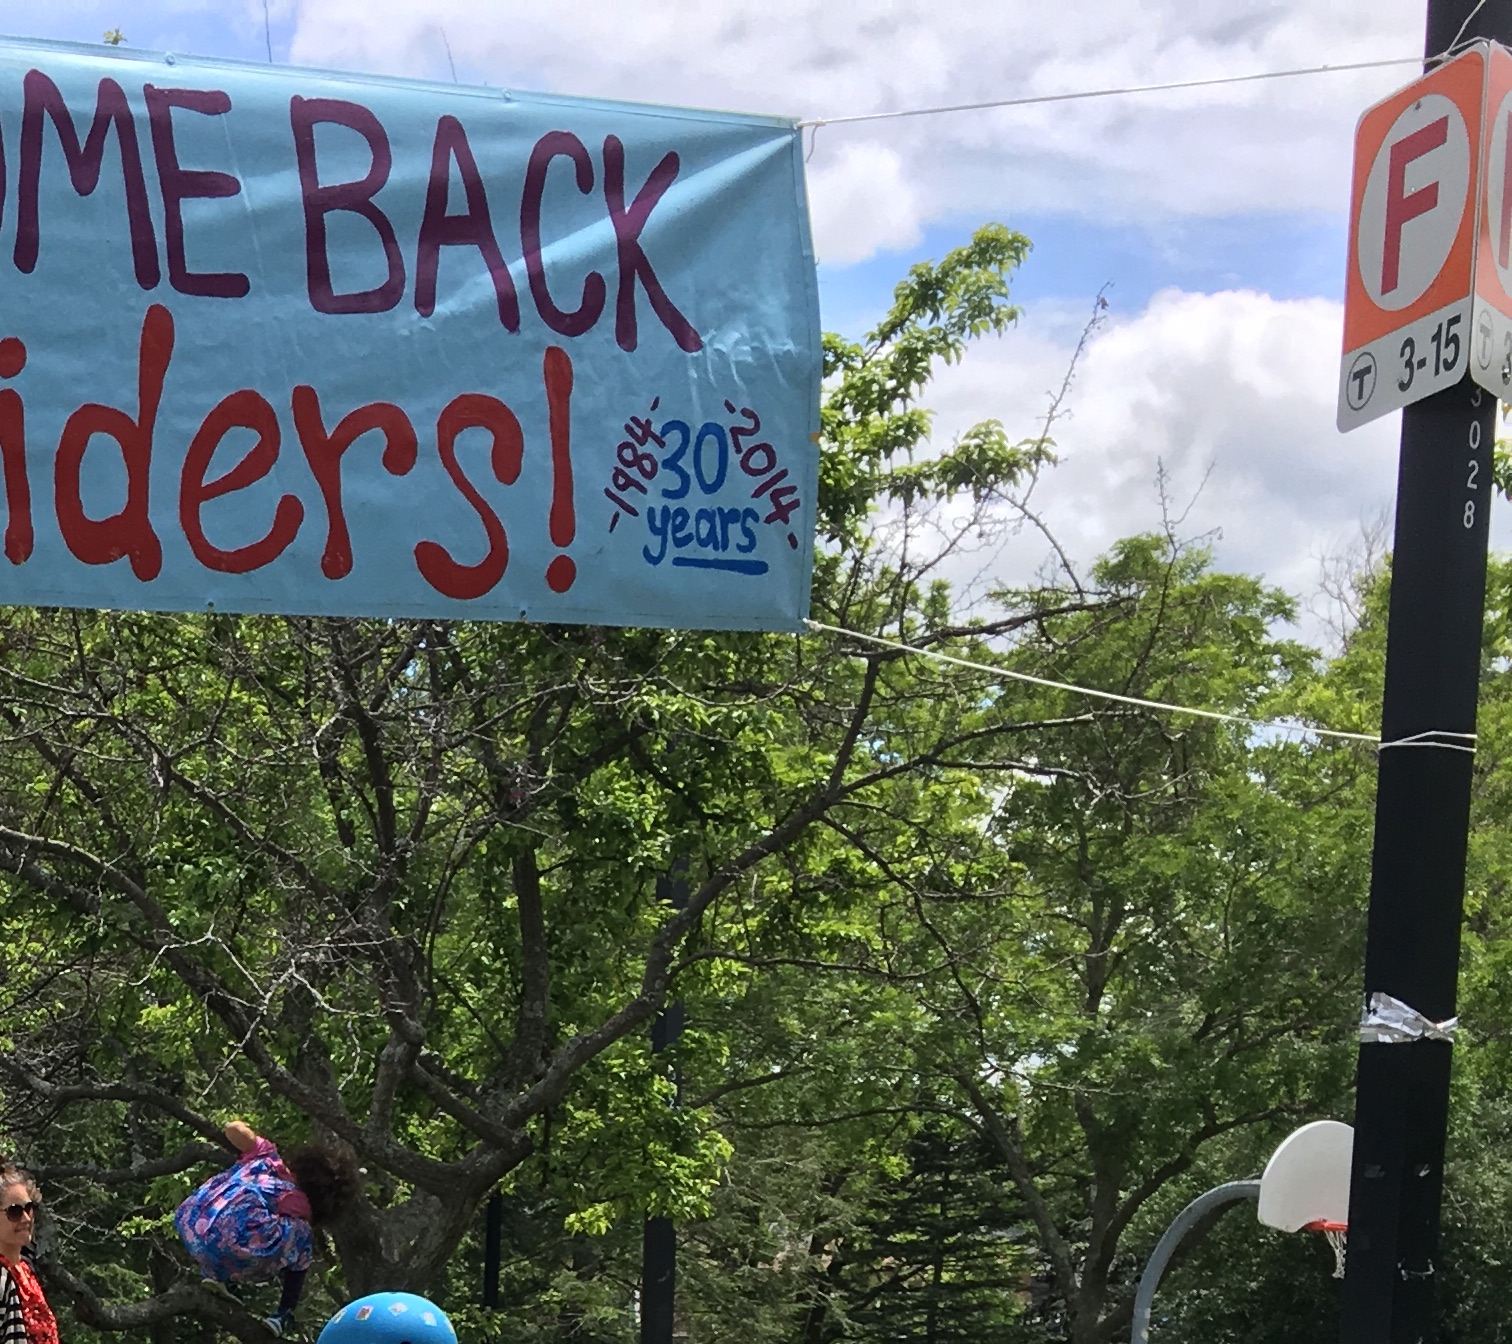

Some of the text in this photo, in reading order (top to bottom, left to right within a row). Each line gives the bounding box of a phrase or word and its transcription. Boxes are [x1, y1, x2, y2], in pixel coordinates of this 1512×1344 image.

[290, 94, 702, 352] BACK
[1381, 115, 1449, 296] F
[1352, 365, 1372, 400] T
[1398, 313, 1461, 393] 3-15
[661, 420, 729, 500] 30
[643, 505, 760, 566] years
